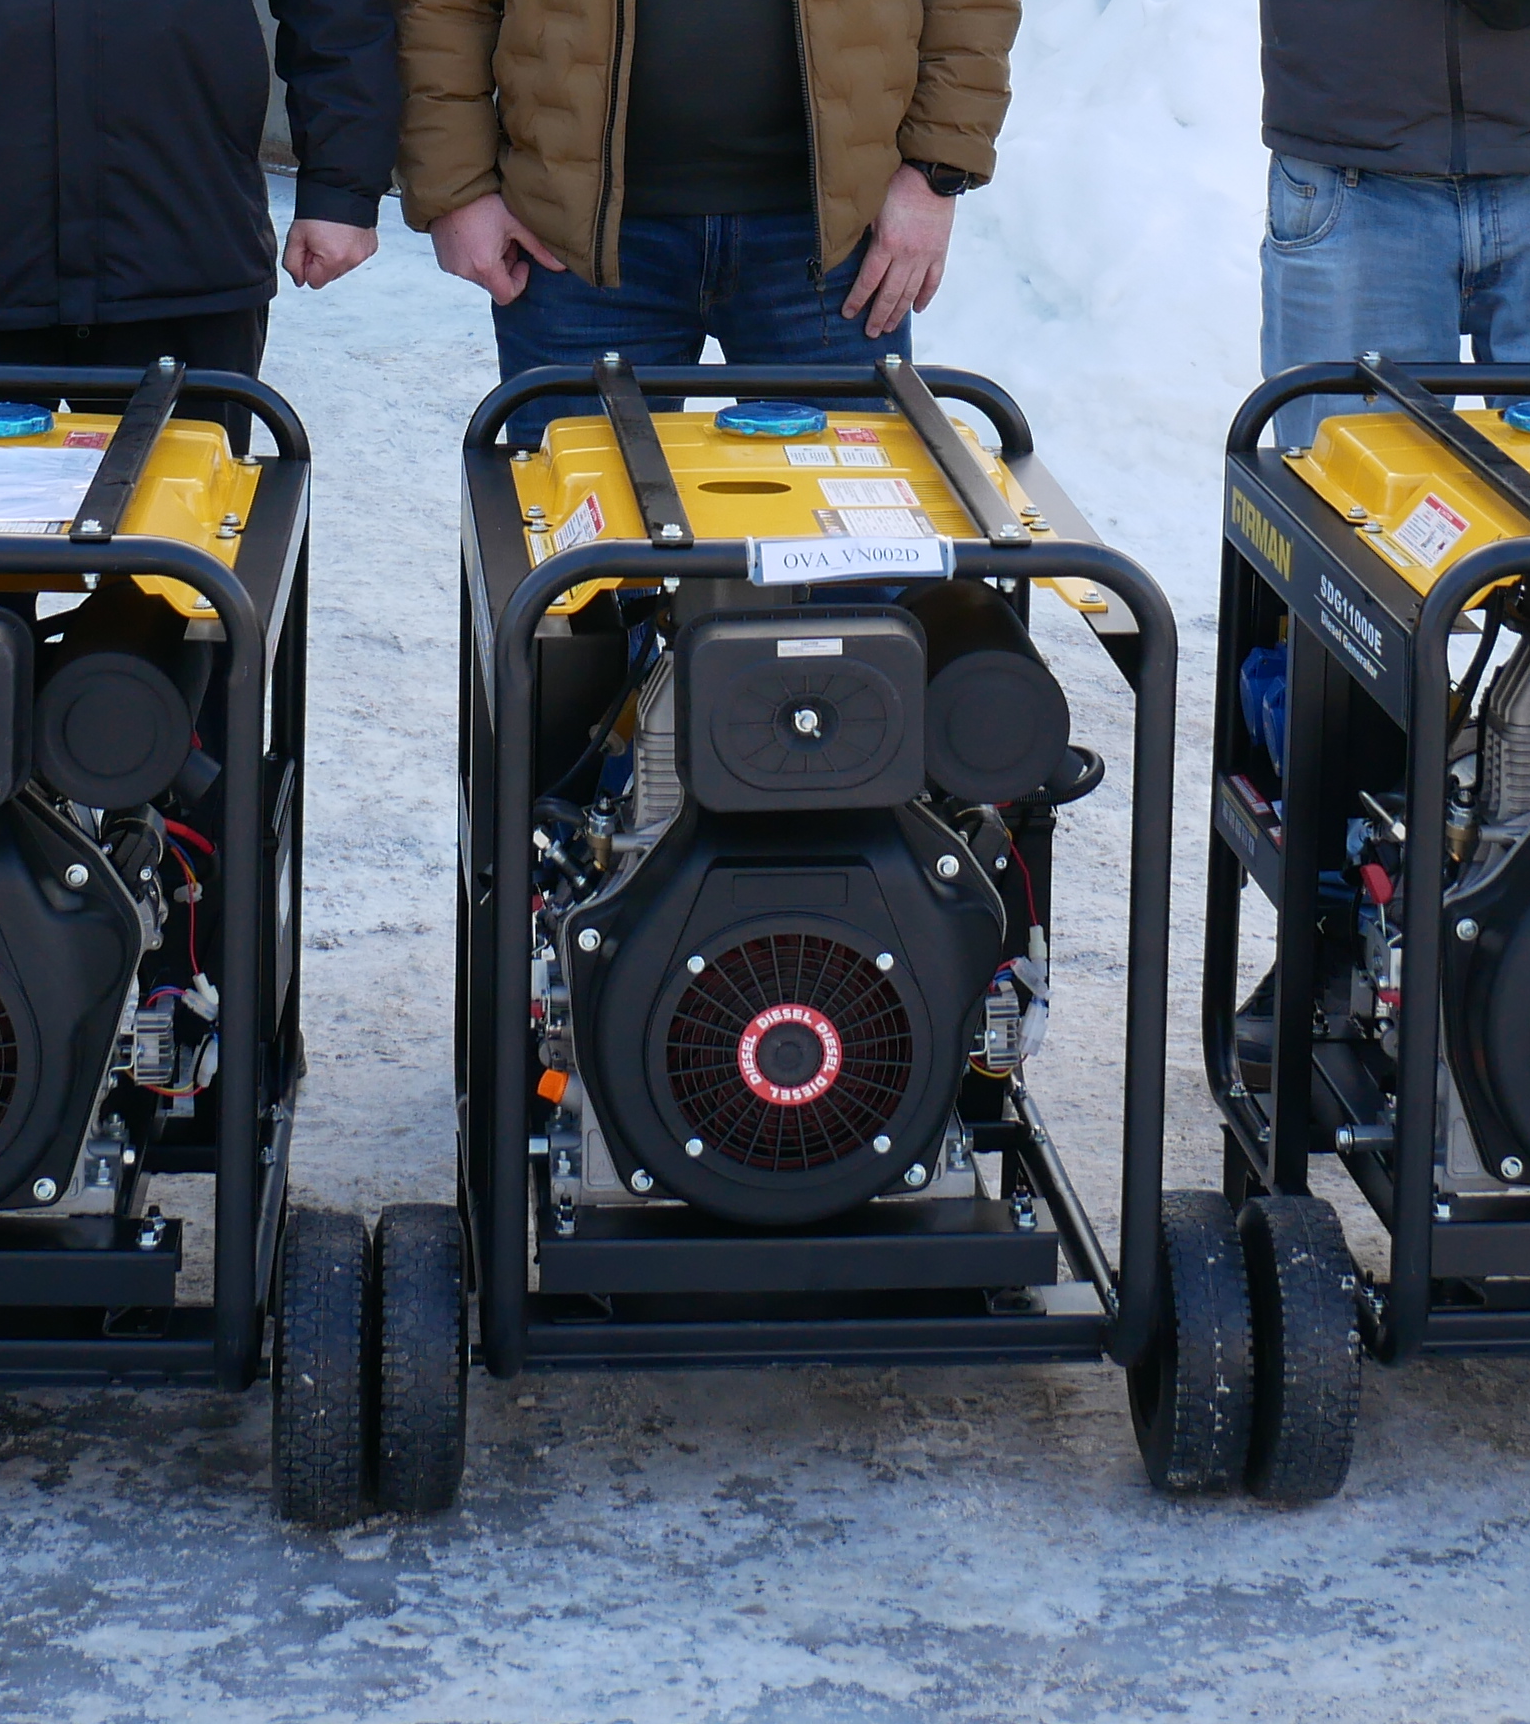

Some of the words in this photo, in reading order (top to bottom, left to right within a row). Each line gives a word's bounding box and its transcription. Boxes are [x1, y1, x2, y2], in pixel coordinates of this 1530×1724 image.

[783, 547, 920, 570] OVA_VN002D
[1320, 574, 1382, 656] SDG11000E
[756, 1008, 812, 1030] DIESEL
[742, 1035, 762, 1085] DIESEL
[815, 1021, 838, 1072] DIESEL
[770, 1075, 828, 1100] DIESEL
